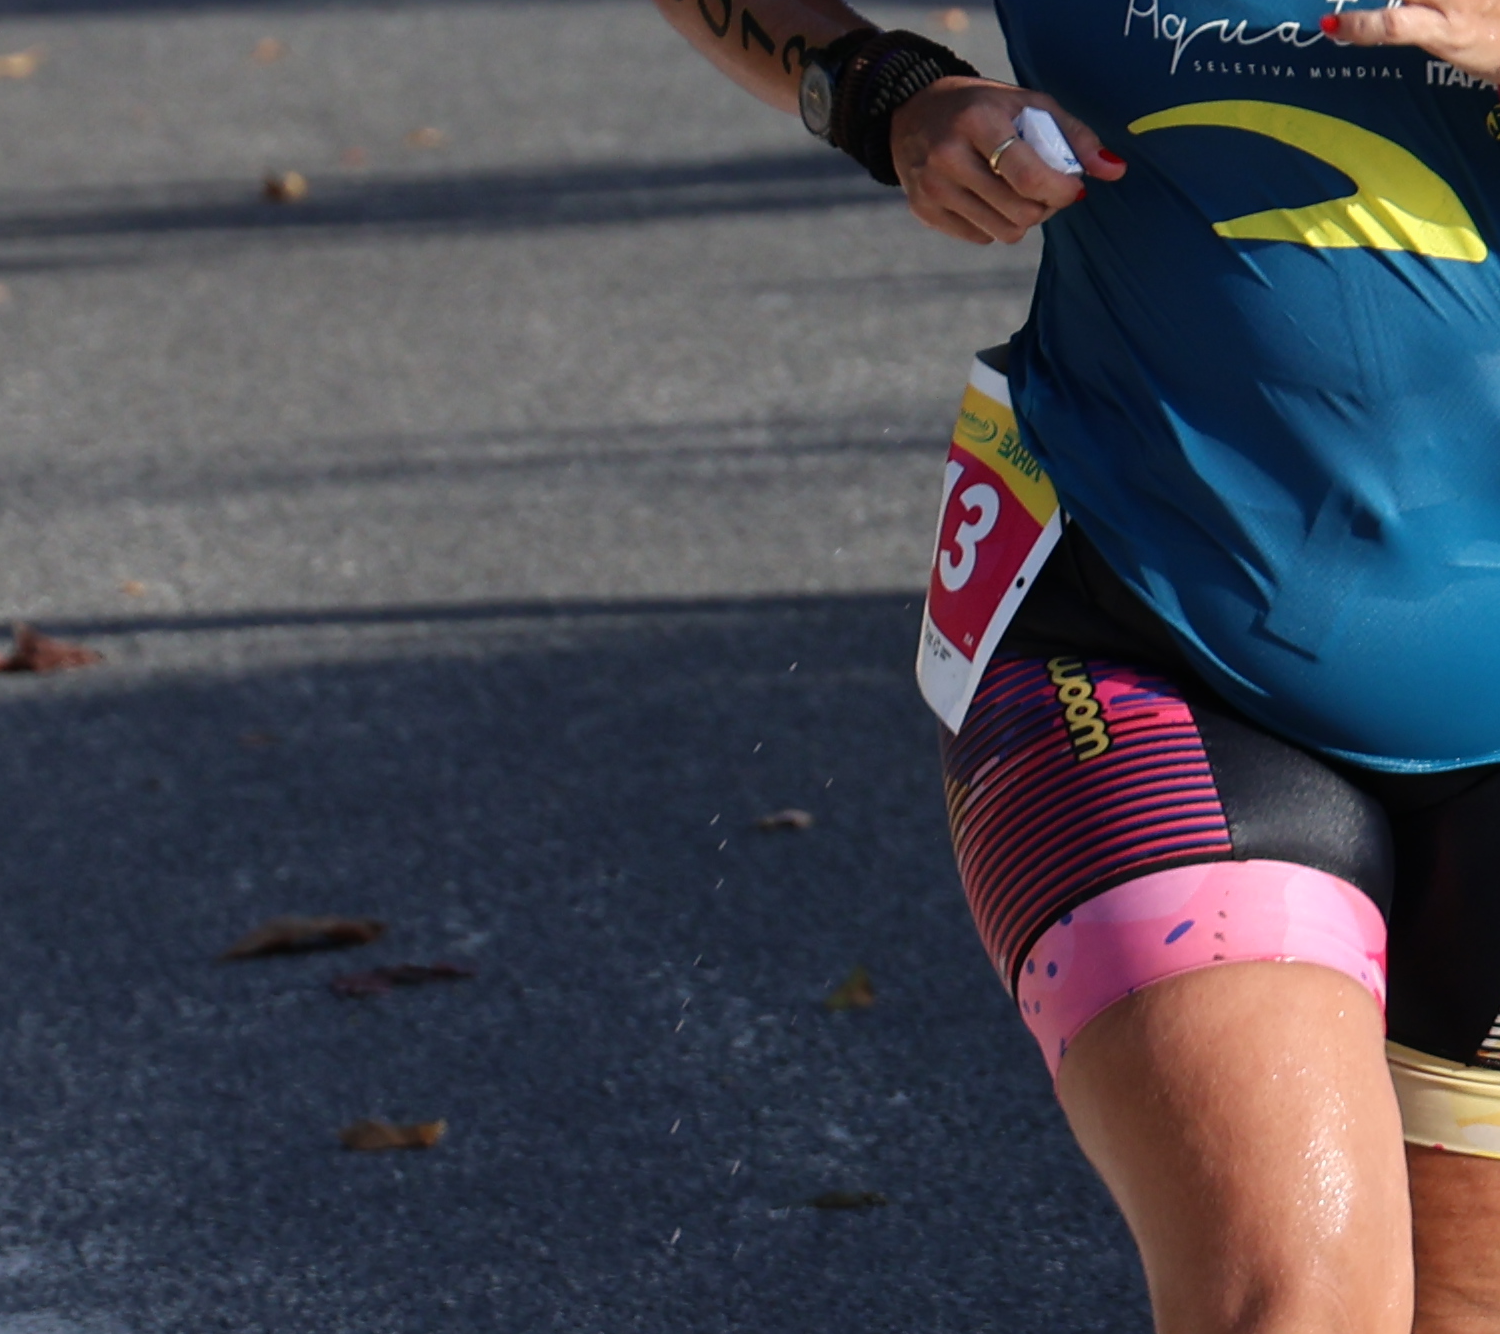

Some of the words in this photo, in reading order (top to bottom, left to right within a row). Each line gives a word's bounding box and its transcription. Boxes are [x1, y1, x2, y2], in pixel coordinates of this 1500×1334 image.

[1193, 60, 1296, 77] SELETIVA
[1310, 66, 1403, 79] MUNDIAL
[1046, 655, 1110, 762] woom
